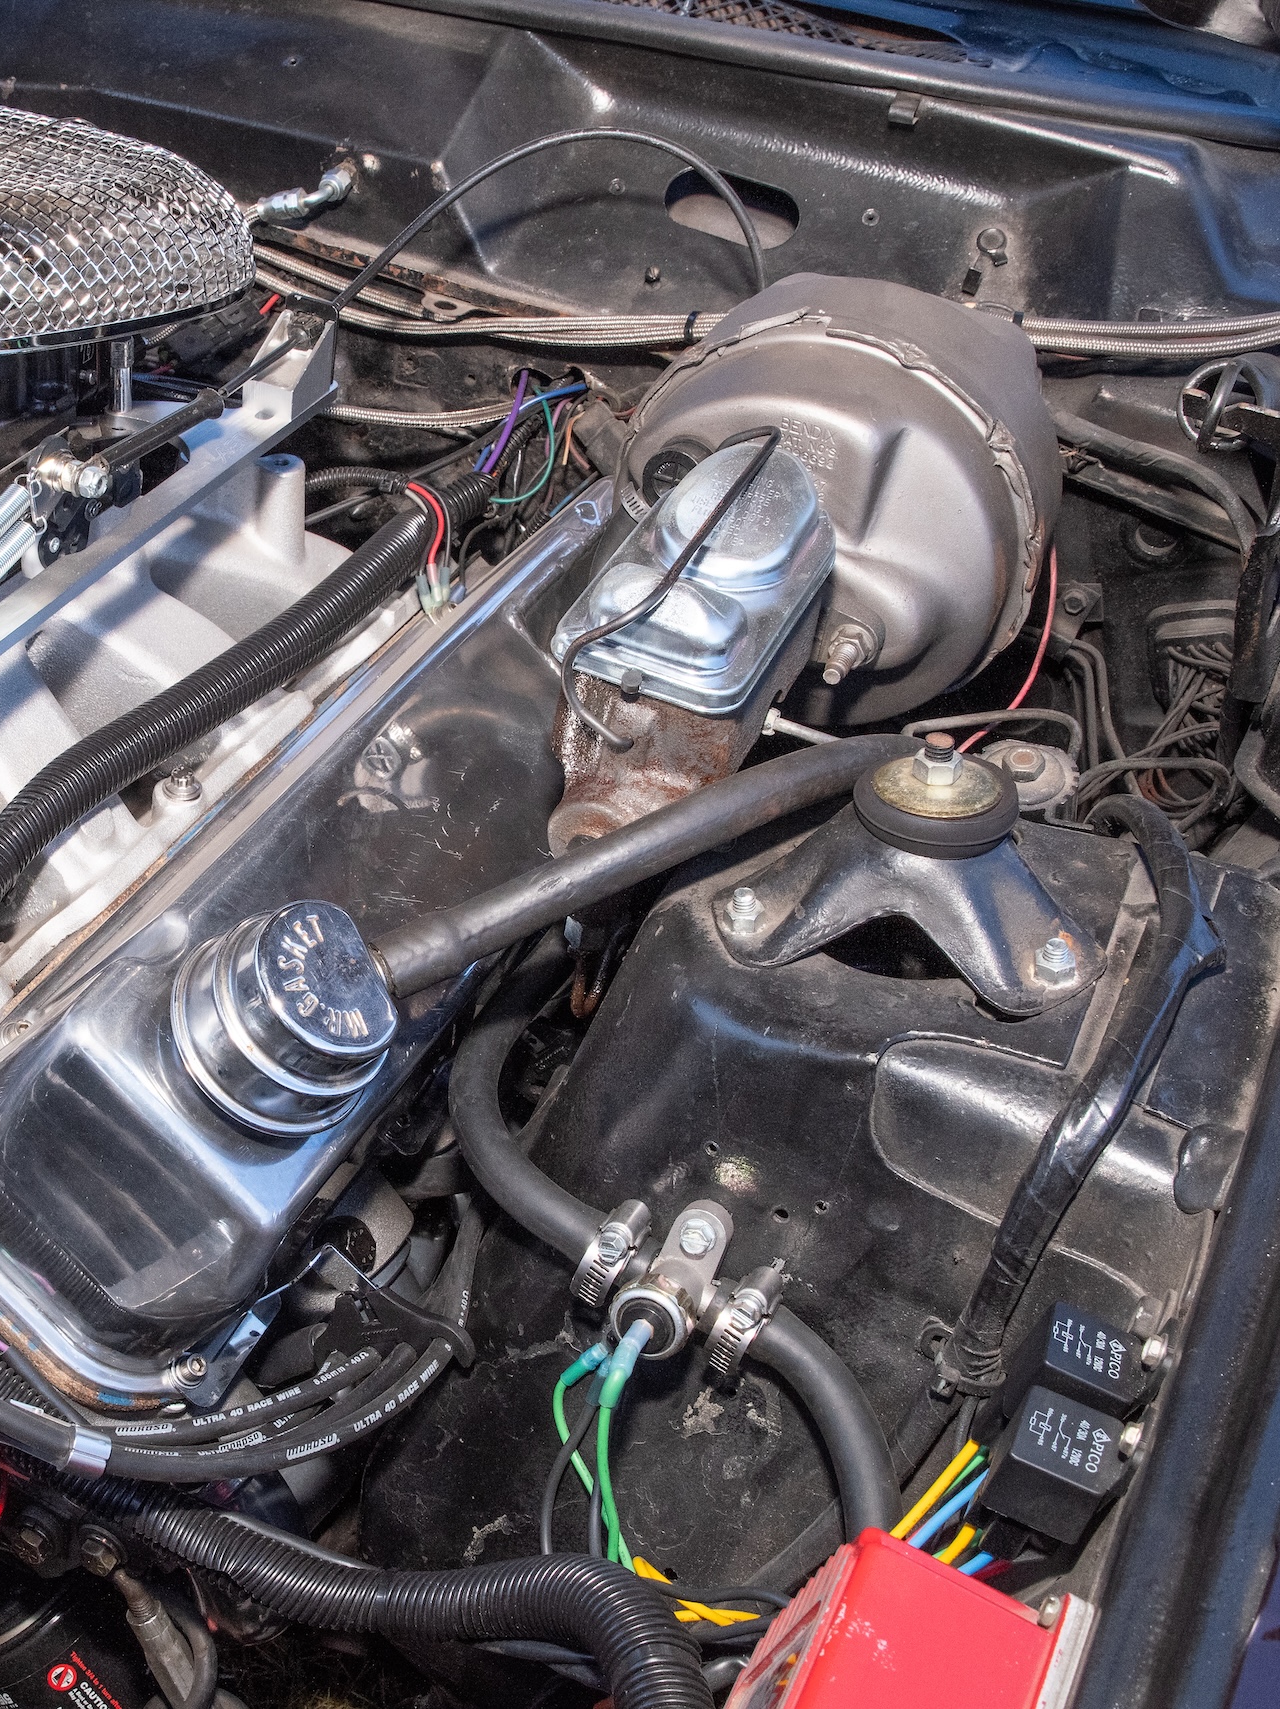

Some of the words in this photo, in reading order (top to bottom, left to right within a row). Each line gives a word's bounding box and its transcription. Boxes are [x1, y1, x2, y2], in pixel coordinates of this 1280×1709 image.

[780, 417, 837, 445] BENDIX
[277, 914, 324, 1018] GASKET
[323, 1006, 369, 1038] MR.
[1108, 1350, 1122, 1379] PICO
[115, 1423, 173, 1436] MOROSO
[193, 1412, 227, 1427] ULTRA
[230, 1407, 243, 1418] 40
[247, 1399, 273, 1413] RACE
[276, 1387, 302, 1403] WIRE
[286, 1433, 337, 1460] MOROSO
[353, 1411, 382, 1433] ULTRA
[384, 1400, 397, 1413] 40
[398, 1381, 420, 1403] RACE
[420, 1359, 440, 1383] WIRE
[1085, 1441, 1105, 1473] PICO
[80, 1682, 109, 1709] CAUTIO
